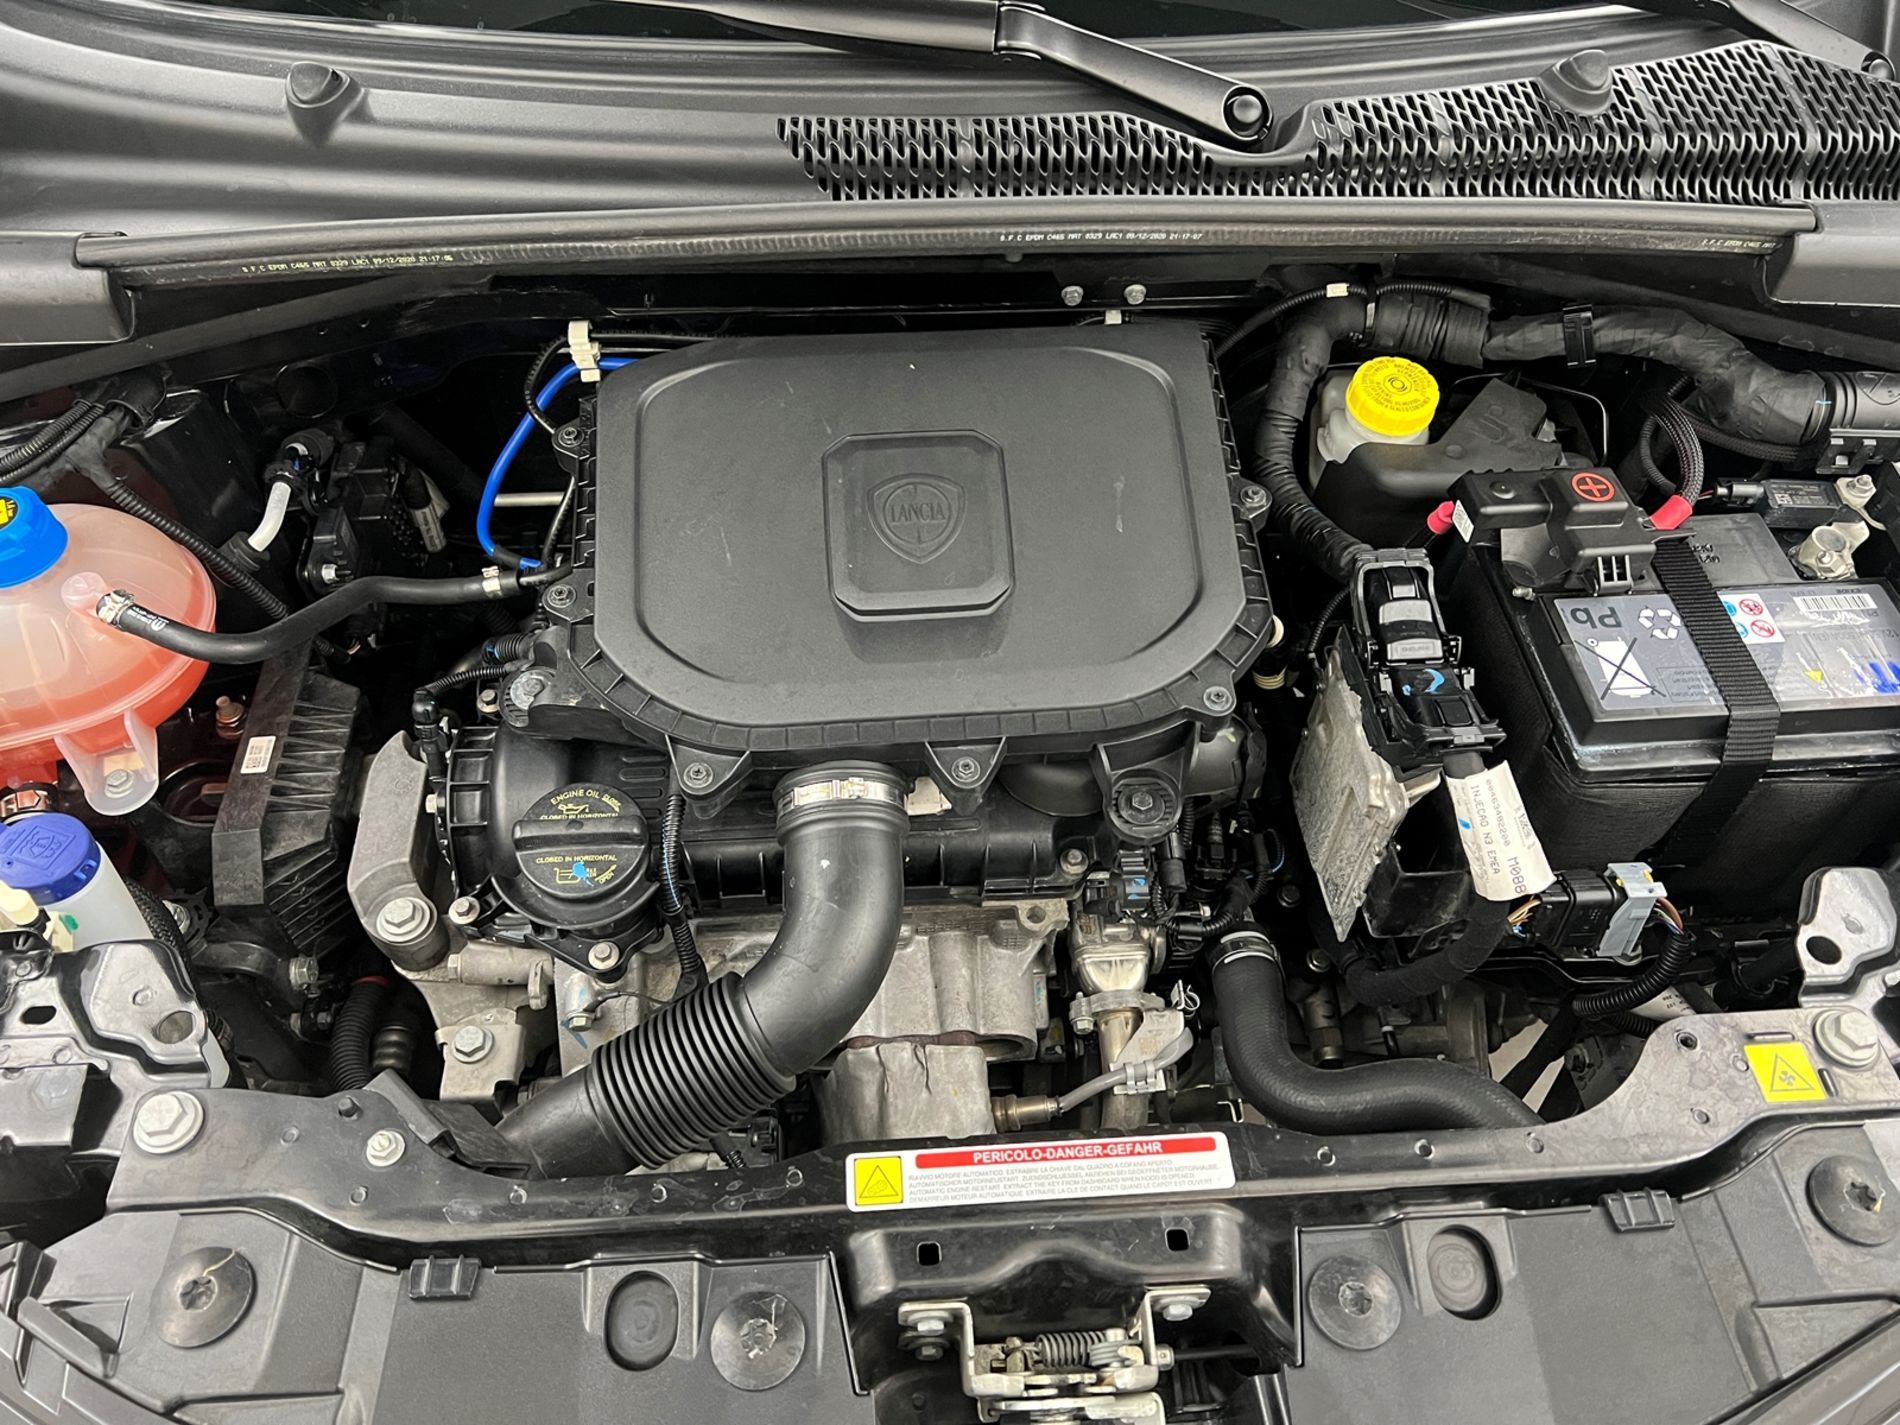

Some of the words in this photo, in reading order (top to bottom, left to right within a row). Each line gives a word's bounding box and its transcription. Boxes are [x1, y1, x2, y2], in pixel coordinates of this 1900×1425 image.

[889, 502, 948, 523] LANCIA
[1570, 606, 1622, 630] Pb
[550, 789, 585, 805] ENGINE
[586, 789, 600, 799] OIL
[536, 855, 563, 864] CLOSED
[574, 854, 617, 862] HORIZONTAL
[1487, 850, 1501, 875] EMEA
[973, 1141, 1163, 1164] PERICOLO-DANGER-GEFAHR
[946, 1185, 970, 1193] ENGINE
[1003, 1182, 1031, 1190] EXTRACT
